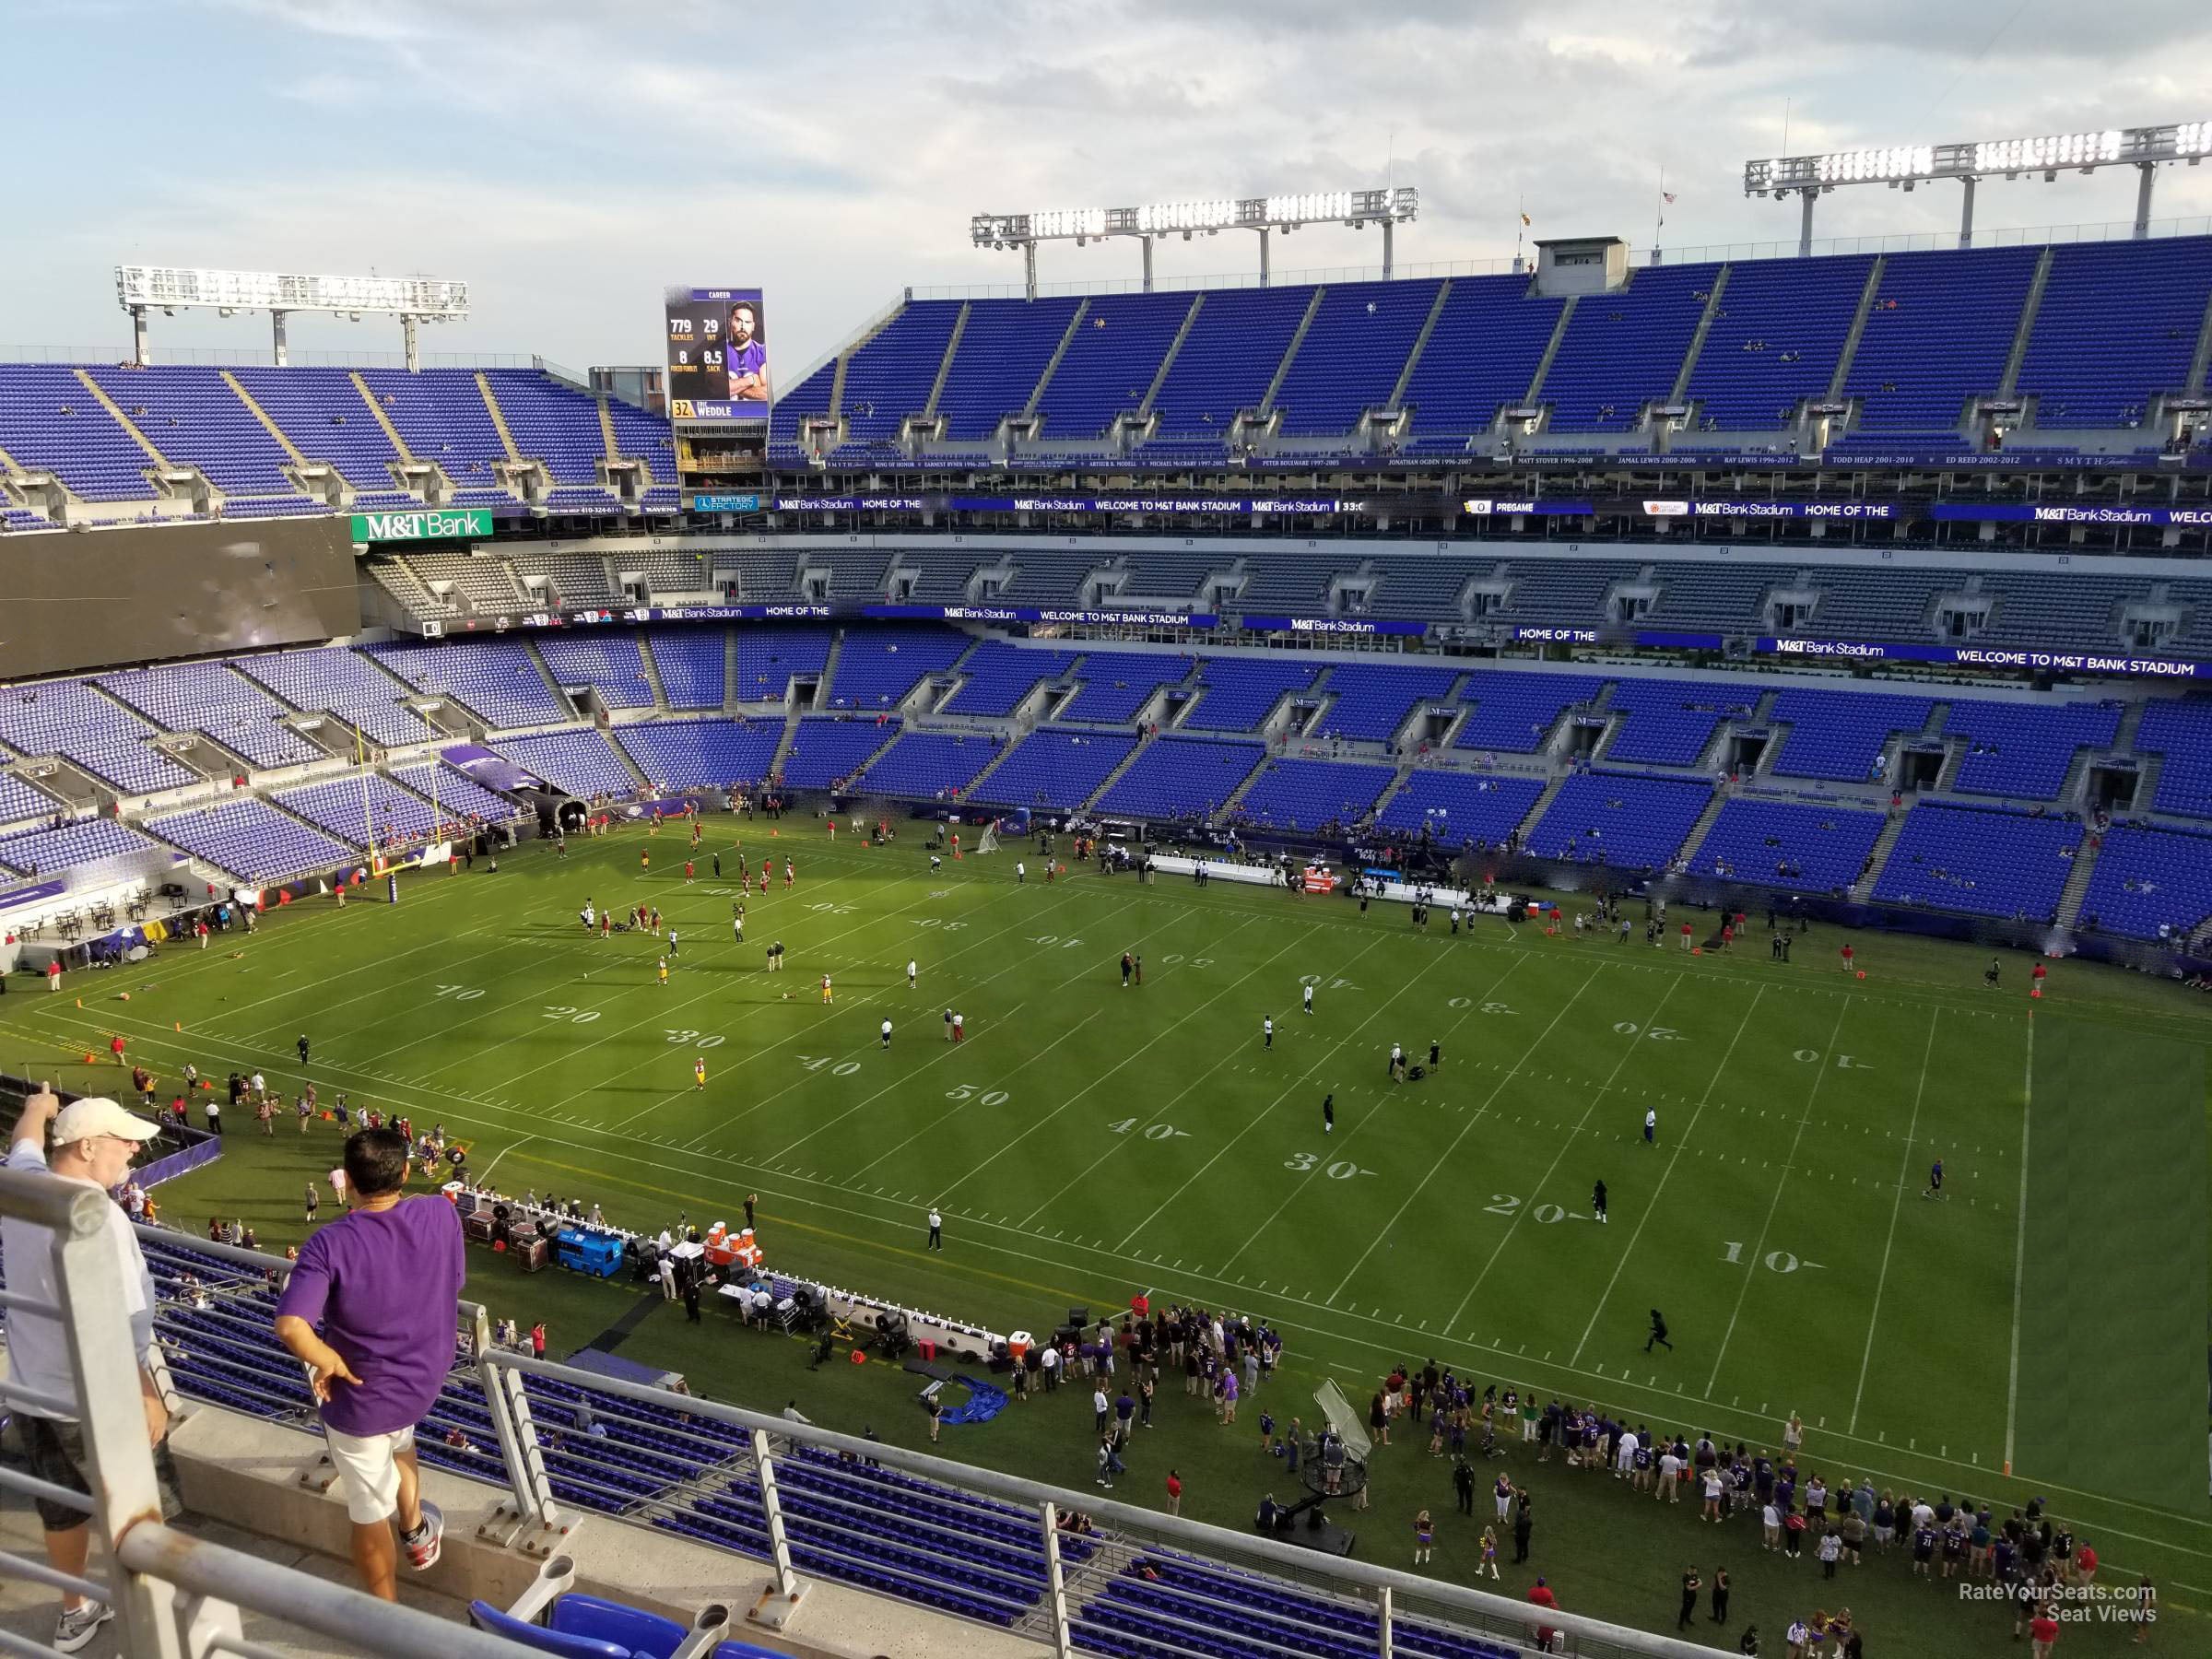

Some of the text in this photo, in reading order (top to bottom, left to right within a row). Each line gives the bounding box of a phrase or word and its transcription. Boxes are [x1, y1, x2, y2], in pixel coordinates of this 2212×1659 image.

[670, 319, 692, 333] 779
[703, 319, 719, 333] 29
[679, 350, 688, 364] 8
[703, 350, 723, 364] 8.5
[676, 402, 688, 416] 32
[697, 406, 732, 417] WEDDLE
[779, 500, 853, 510] M&T Bank Stadium
[862, 500, 921, 508] HOME OF THE
[1014, 500, 1085, 510] M&T Bank Stadium
[1095, 501, 1241, 512] WELCOME TO M&T BANK STADIUM
[1252, 501, 1329, 512] M&T Bank Stadium
[1497, 503, 1534, 512] PREGAME
[1695, 503, 1723, 514] M&T
[1723, 503, 1748, 515] Bank
[1748, 504, 1793, 515] Stadium
[1805, 505, 1888, 517] HOME OF THE
[2034, 508, 2151, 523] M&T Bank Stadium
[2170, 512, 2212, 524] WELC
[366, 512, 481, 539] M&T Bank
[662, 608, 742, 618] M&T Bank Stadium
[766, 606, 829, 616] HOME OF THE
[944, 607, 1017, 619] M&T Bank Stadium
[1041, 611, 1189, 624] WELCOME TO M&T BANK STADIUM
[1291, 619, 1375, 633] M&T Bank Stadium
[1519, 629, 1595, 641] HOME OF THE
[1777, 640, 1884, 656] M&T Bank Stadium
[1956, 650, 2194, 675] WELCOME TO M&T BANK STADIUM
[438, 984, 486, 1001] 10
[543, 1006, 602, 1025] 20
[665, 1029, 727, 1049] 30
[802, 1056, 862, 1076] 40
[945, 1084, 1010, 1106] 50
[1107, 1117, 1174, 1140] 40
[1283, 1152, 1359, 1180] 30
[1481, 1194, 1566, 1225] 20
[1716, 1240, 1800, 1275] 10
[1207, 1364, 1213, 1373] 8
[1637, 1454, 1646, 1464] 52
[1923, 1538, 1932, 1547] 21
[1947, 1539, 1960, 1548] 52
